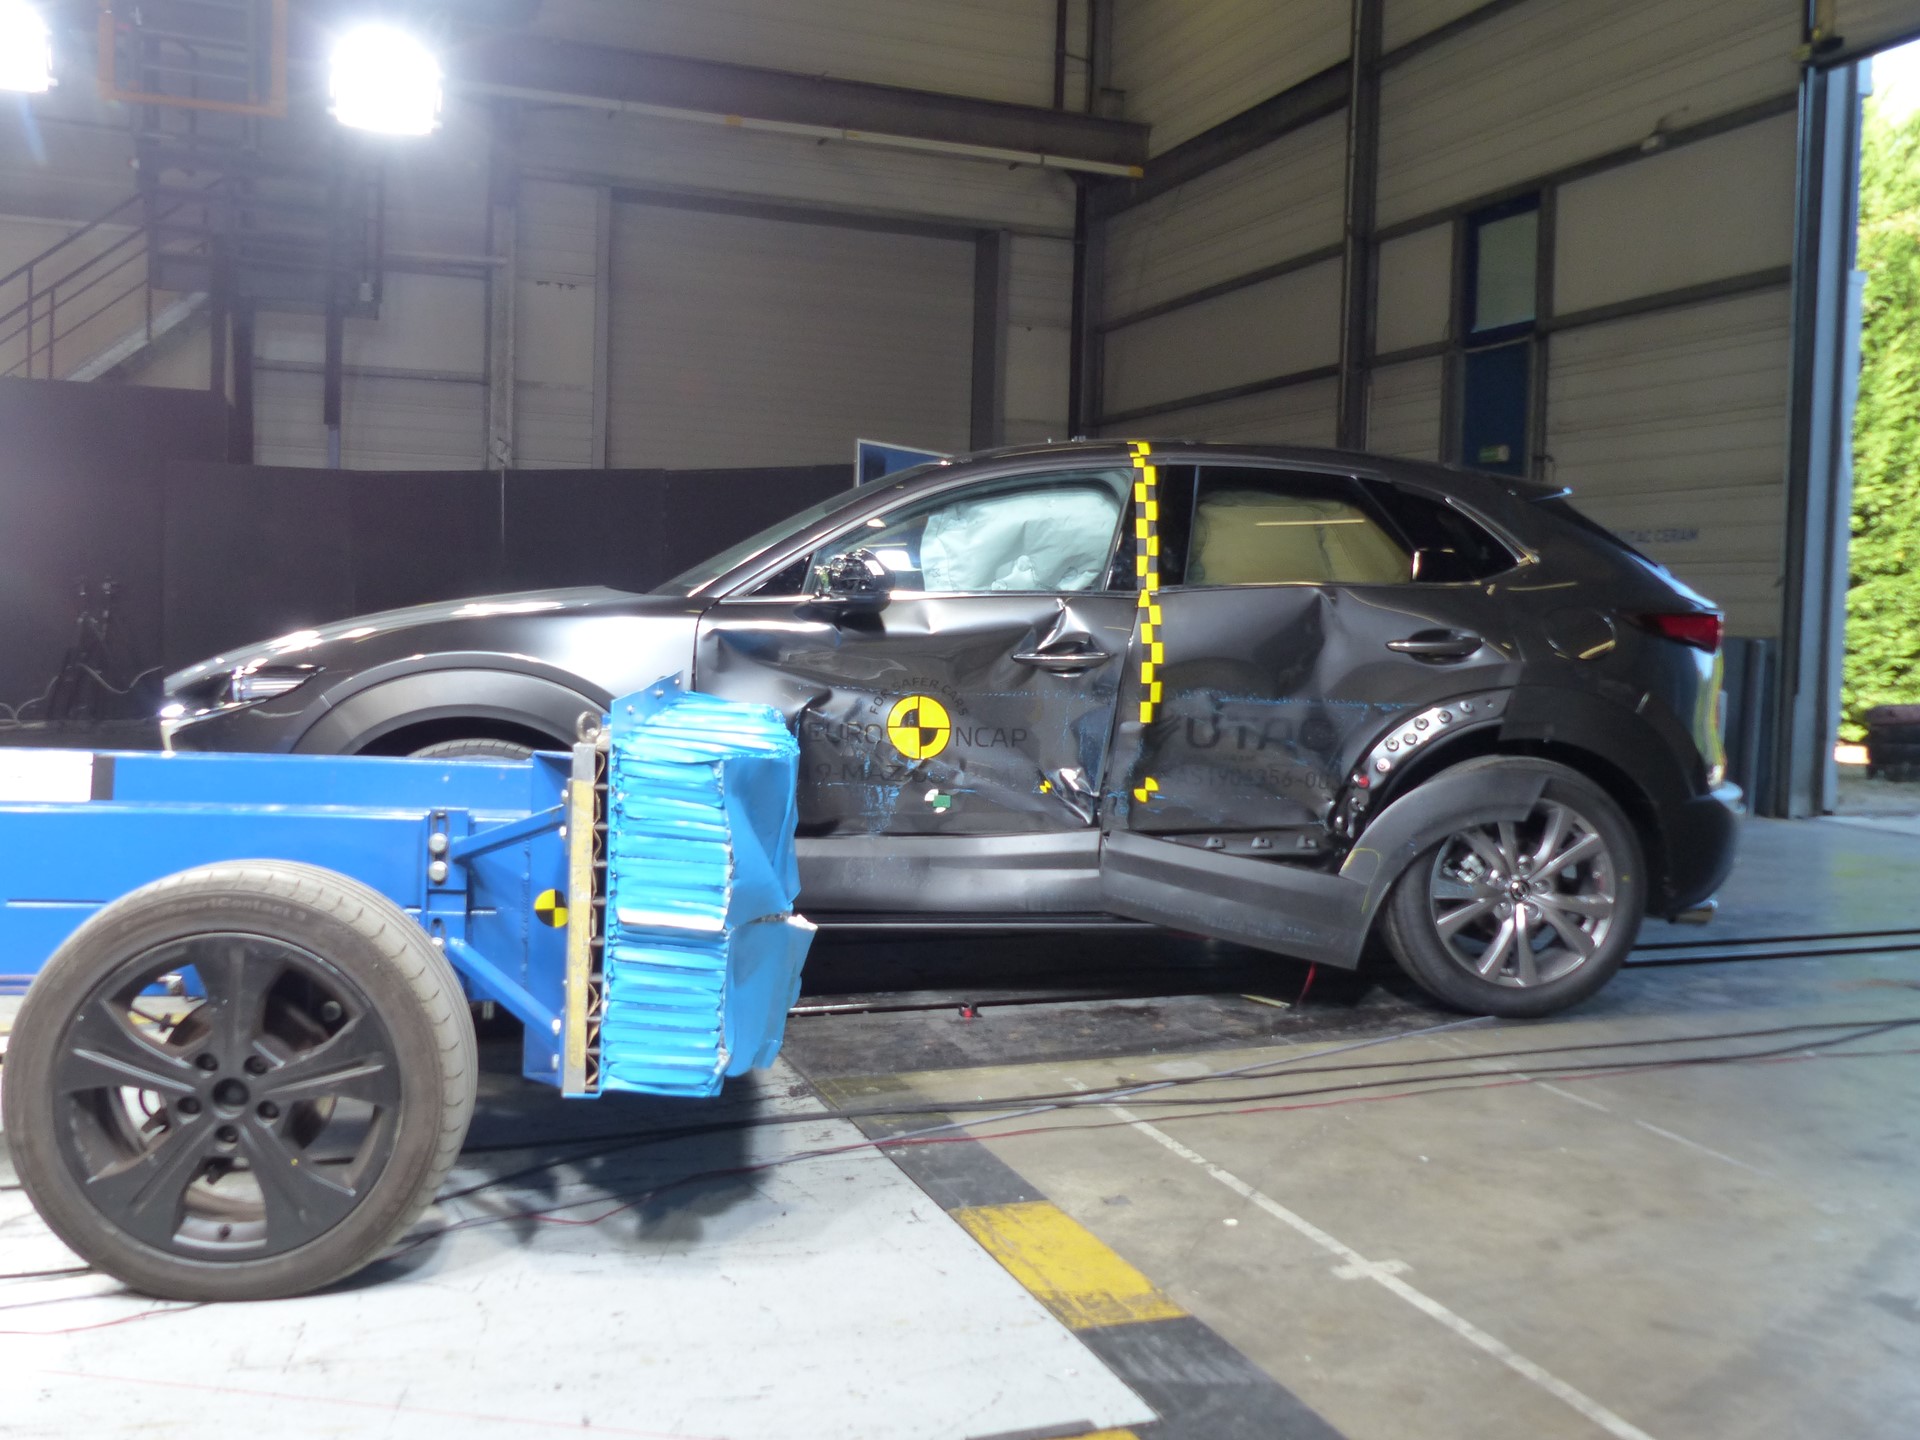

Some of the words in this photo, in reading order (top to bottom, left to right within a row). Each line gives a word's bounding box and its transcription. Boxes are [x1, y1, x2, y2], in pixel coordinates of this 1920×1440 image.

[869, 687, 891, 715] FOR
[892, 676, 939, 691] SAFER
[941, 684, 969, 717] CARS
[808, 721, 883, 745] EURO
[955, 726, 1028, 748] NCAP
